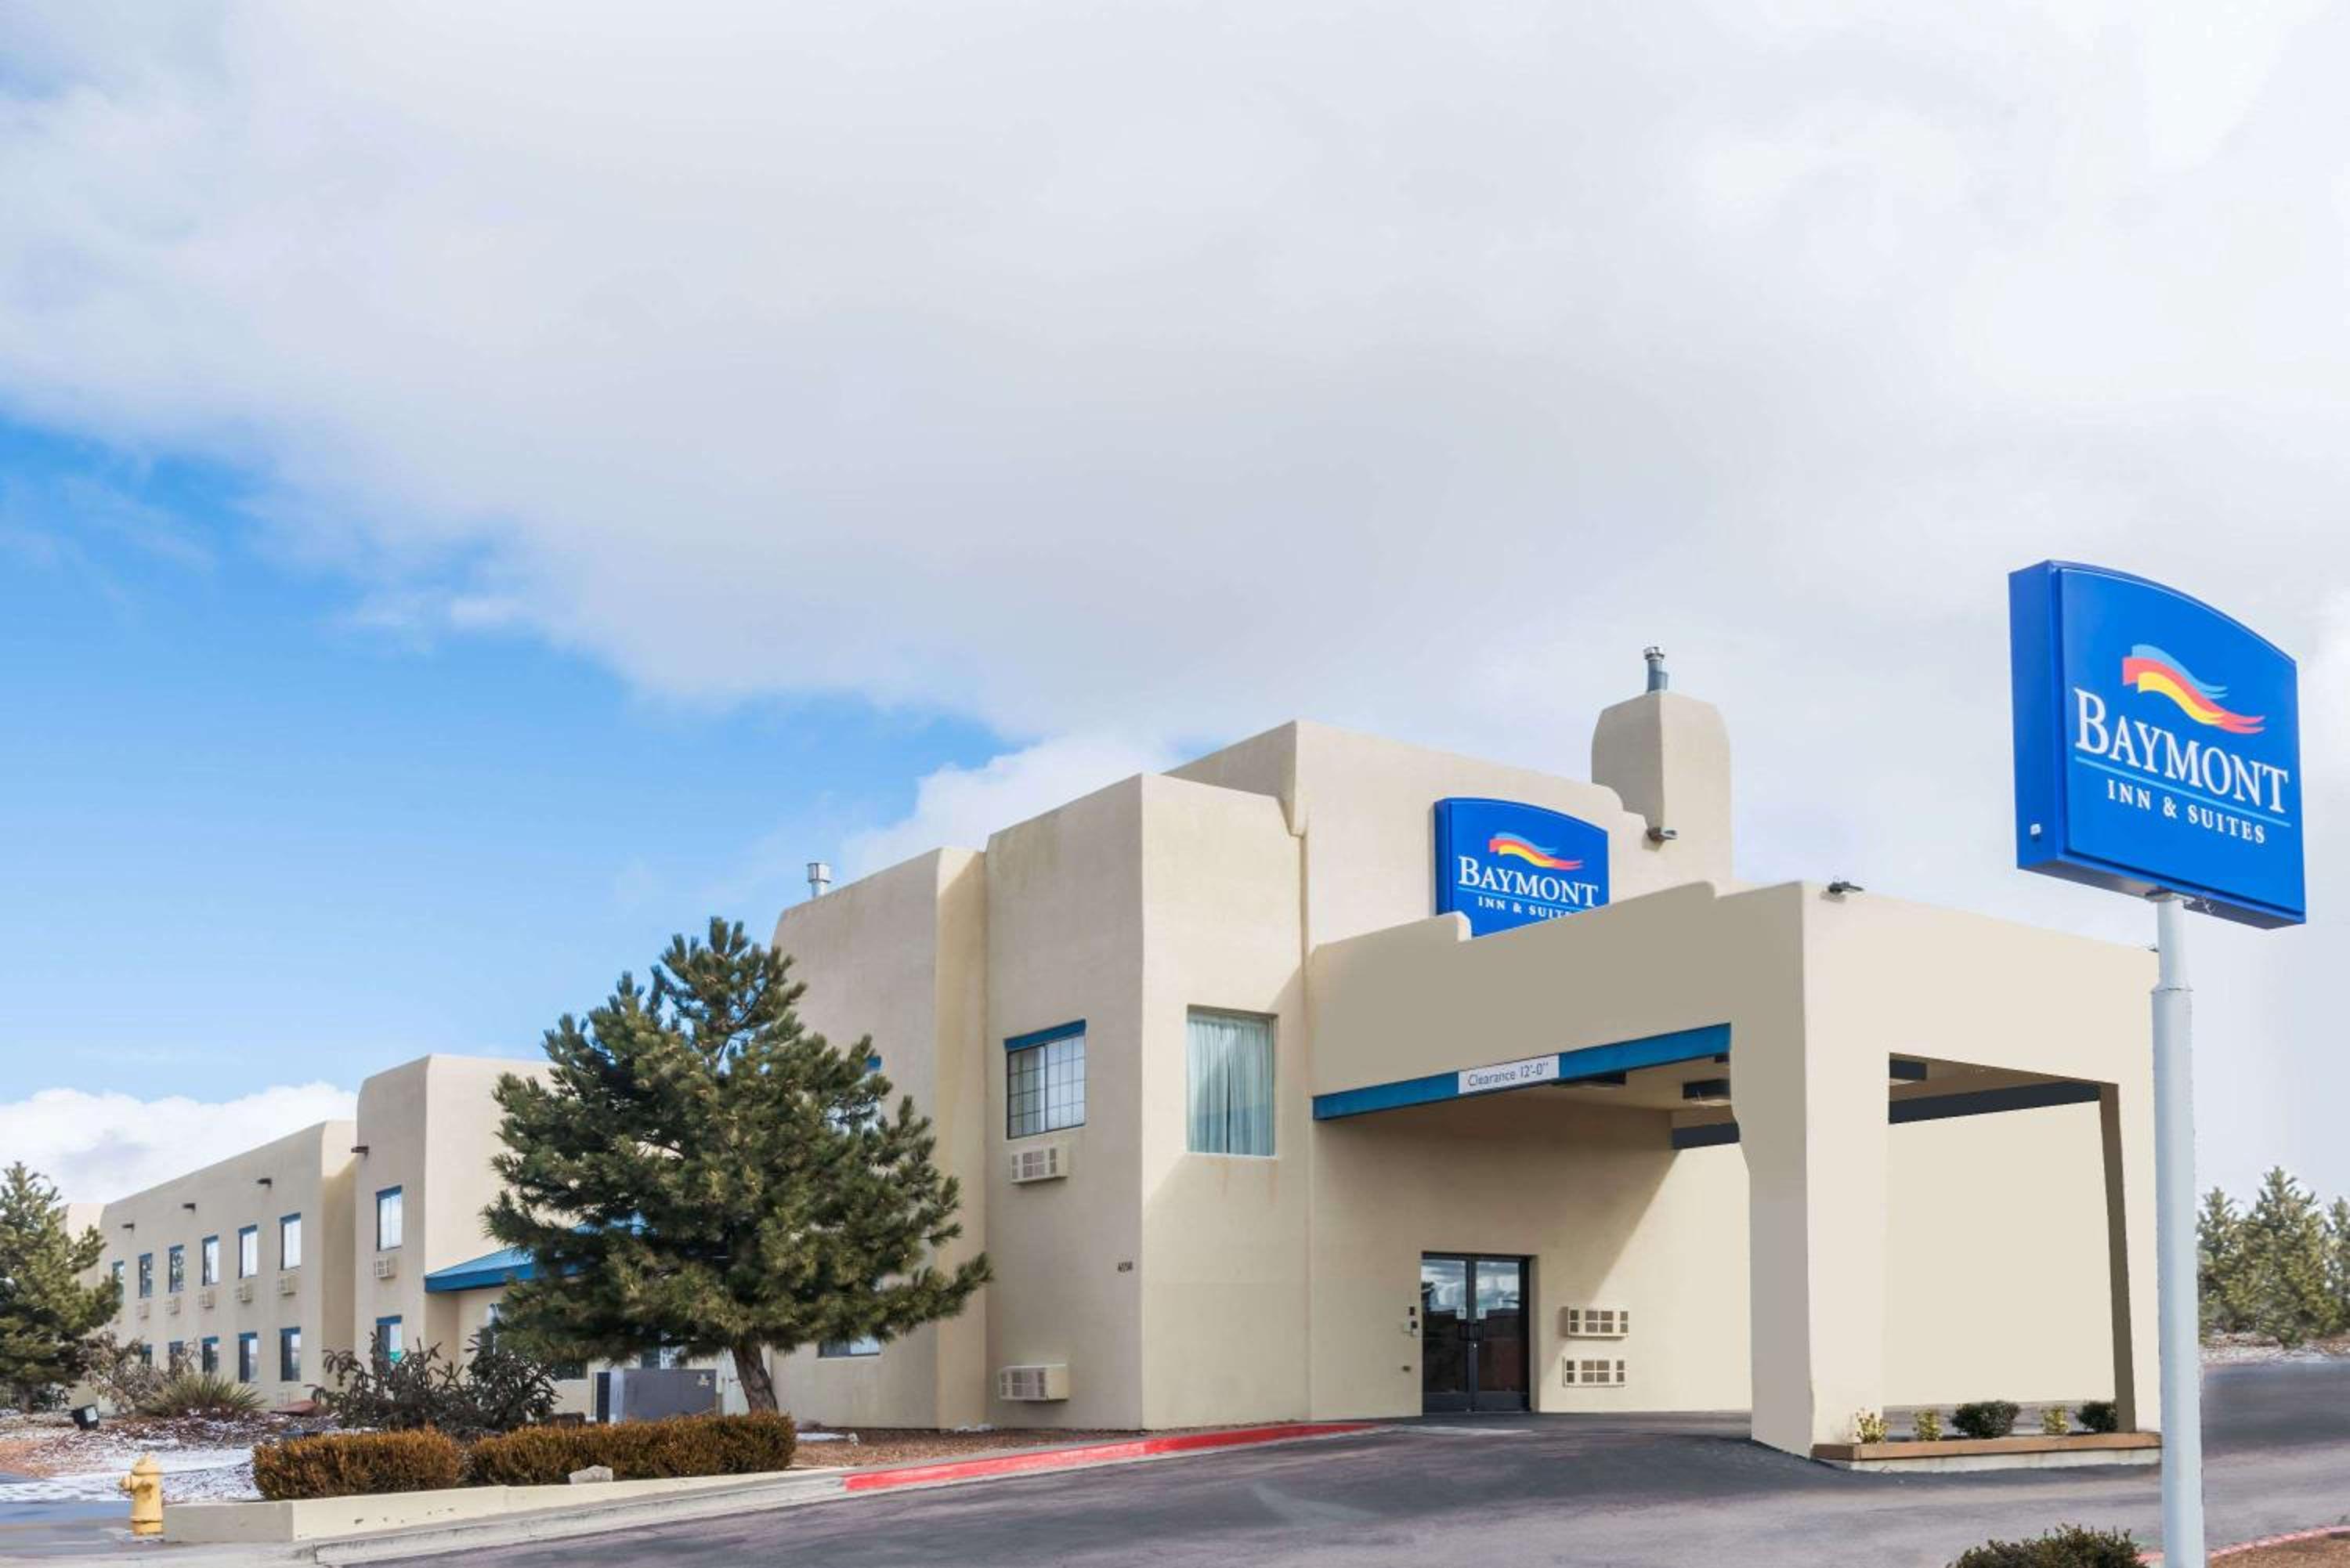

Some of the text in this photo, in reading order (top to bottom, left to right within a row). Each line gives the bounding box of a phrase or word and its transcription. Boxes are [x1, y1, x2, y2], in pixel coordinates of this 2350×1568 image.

[2074, 688, 2287, 813] BAYMONT
[2108, 780, 2265, 844] INN & SUITES
[1458, 856, 1598, 907] BAYMONT
[1478, 897, 1506, 910] INN
[1513, 903, 1522, 913] &
[1469, 1071, 1515, 1086] Clearance
